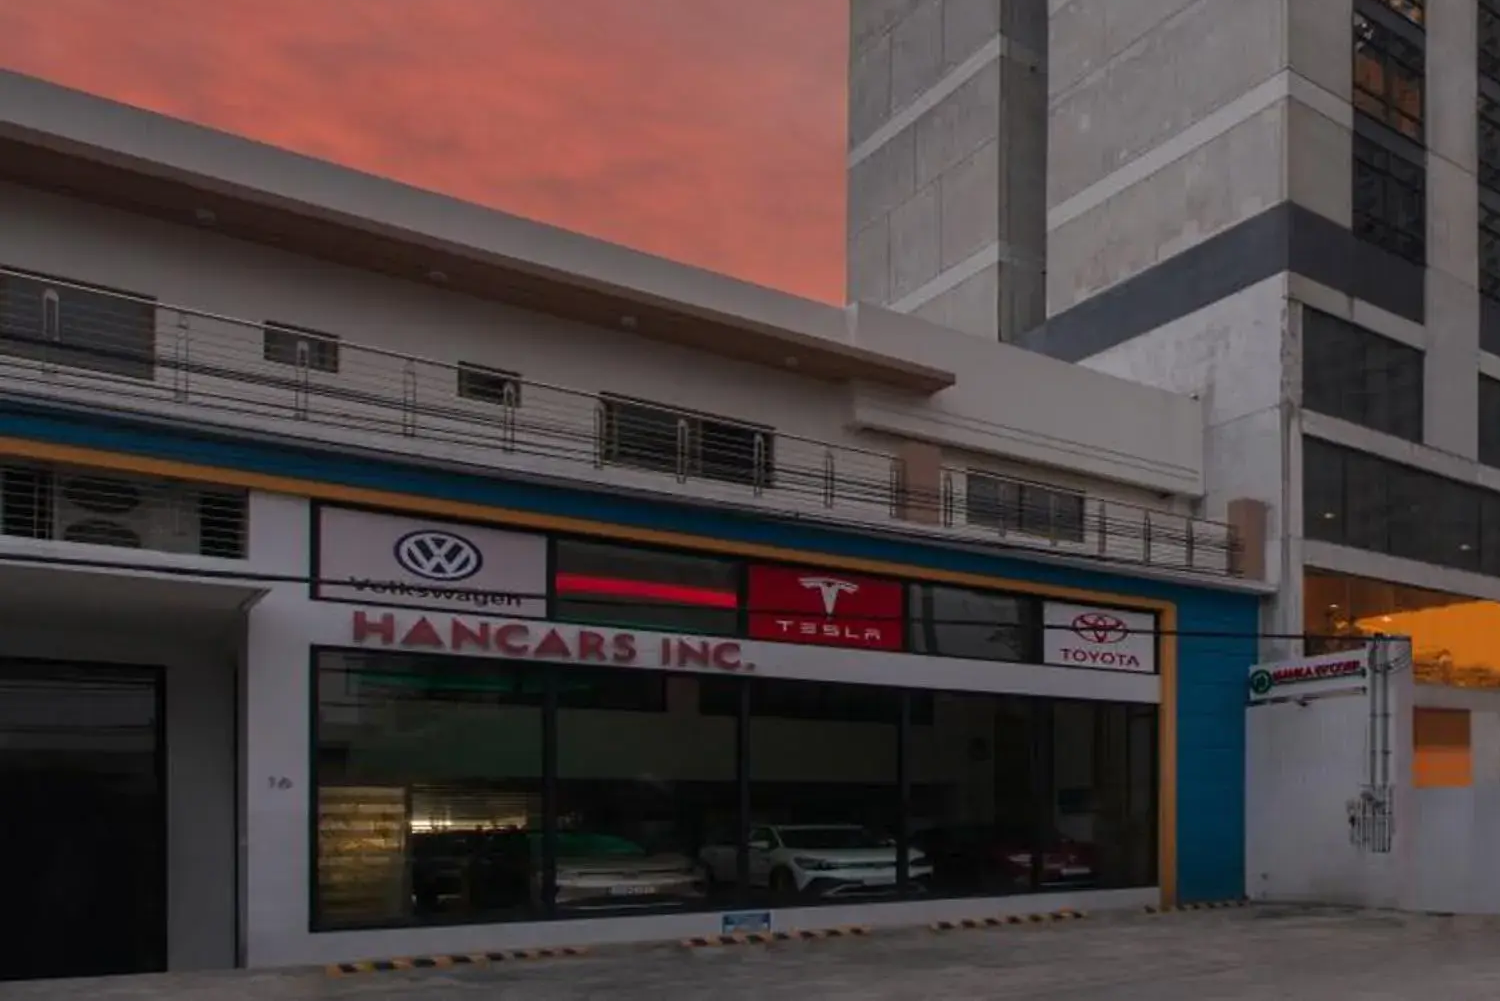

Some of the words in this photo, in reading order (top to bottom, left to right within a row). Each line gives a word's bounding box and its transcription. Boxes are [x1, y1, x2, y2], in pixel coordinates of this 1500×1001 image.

[349, 576, 523, 608] Volkswagen
[352, 610, 637, 665] HANCARS
[660, 637, 757, 672] INC.
[776, 619, 882, 641] TESLA
[1060, 648, 1140, 668] TOYOTA
